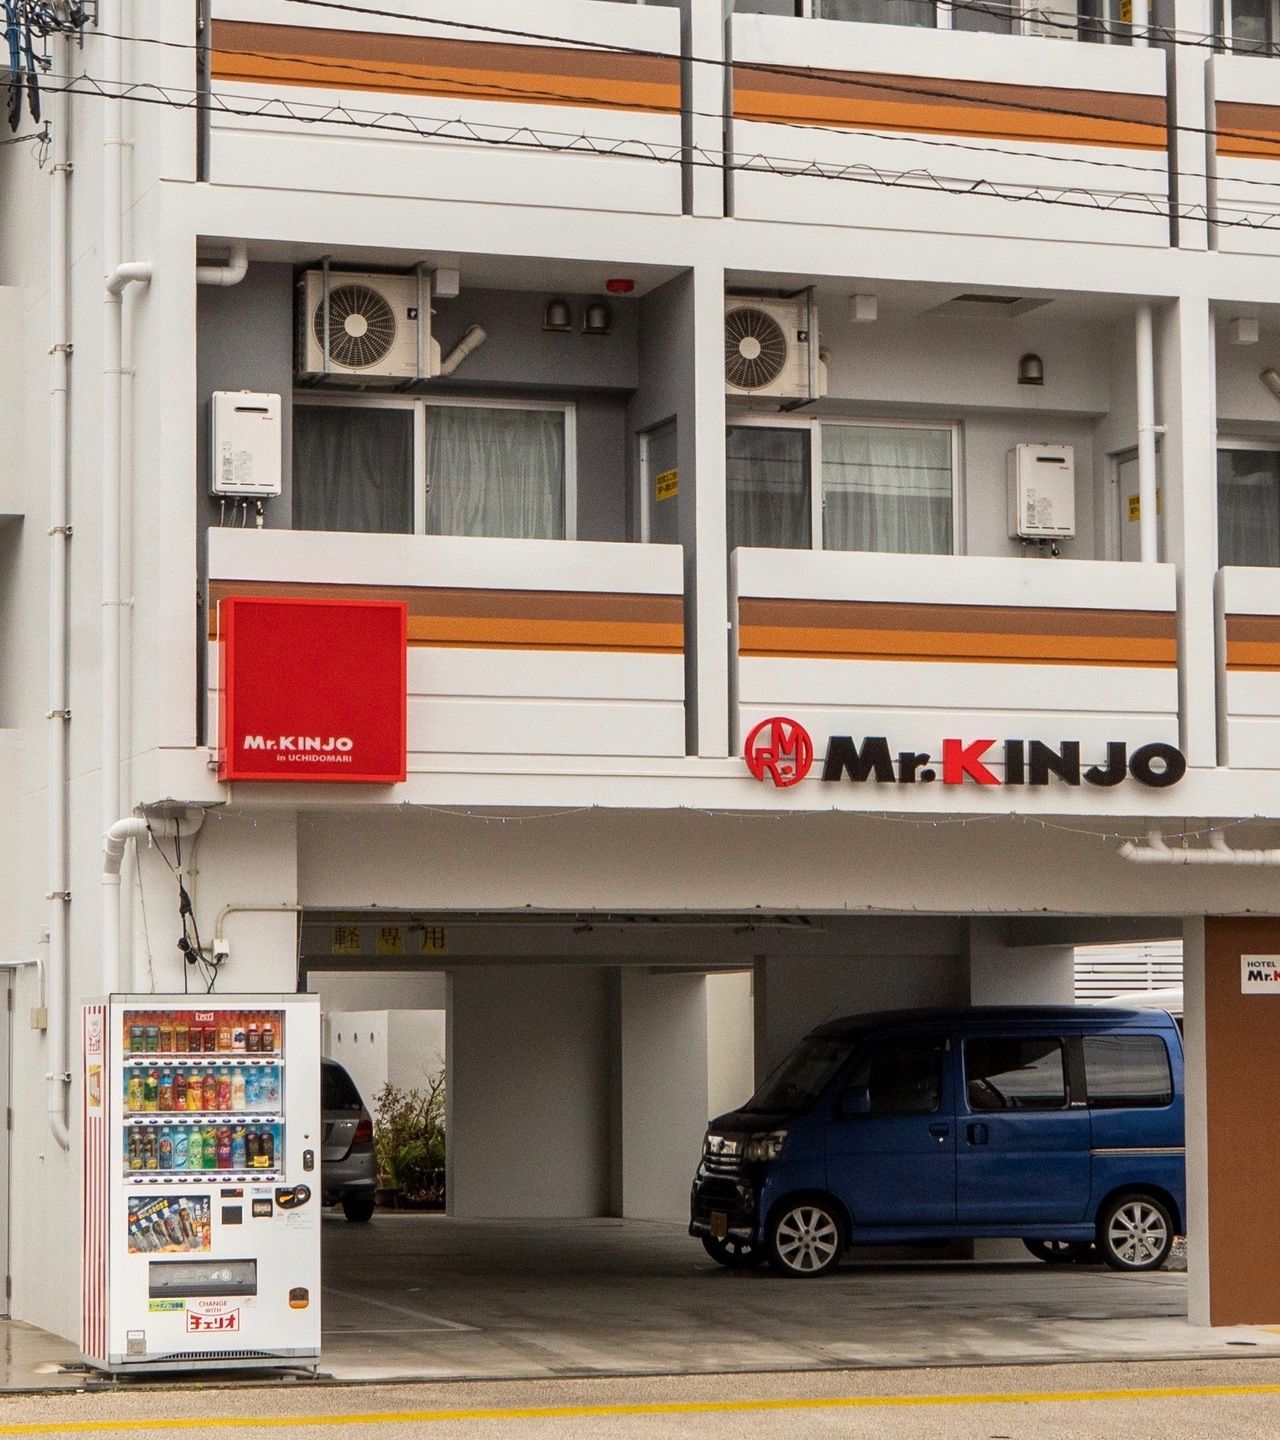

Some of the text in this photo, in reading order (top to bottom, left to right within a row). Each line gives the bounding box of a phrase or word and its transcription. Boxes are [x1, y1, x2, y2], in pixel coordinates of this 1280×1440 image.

[243, 735, 354, 752] Mr.KINJO
[276, 753, 352, 763] in UCHIDOMARI
[821, 735, 1187, 788] Mr.KINJO
[190, 1314, 236, 1330] チェリオ
